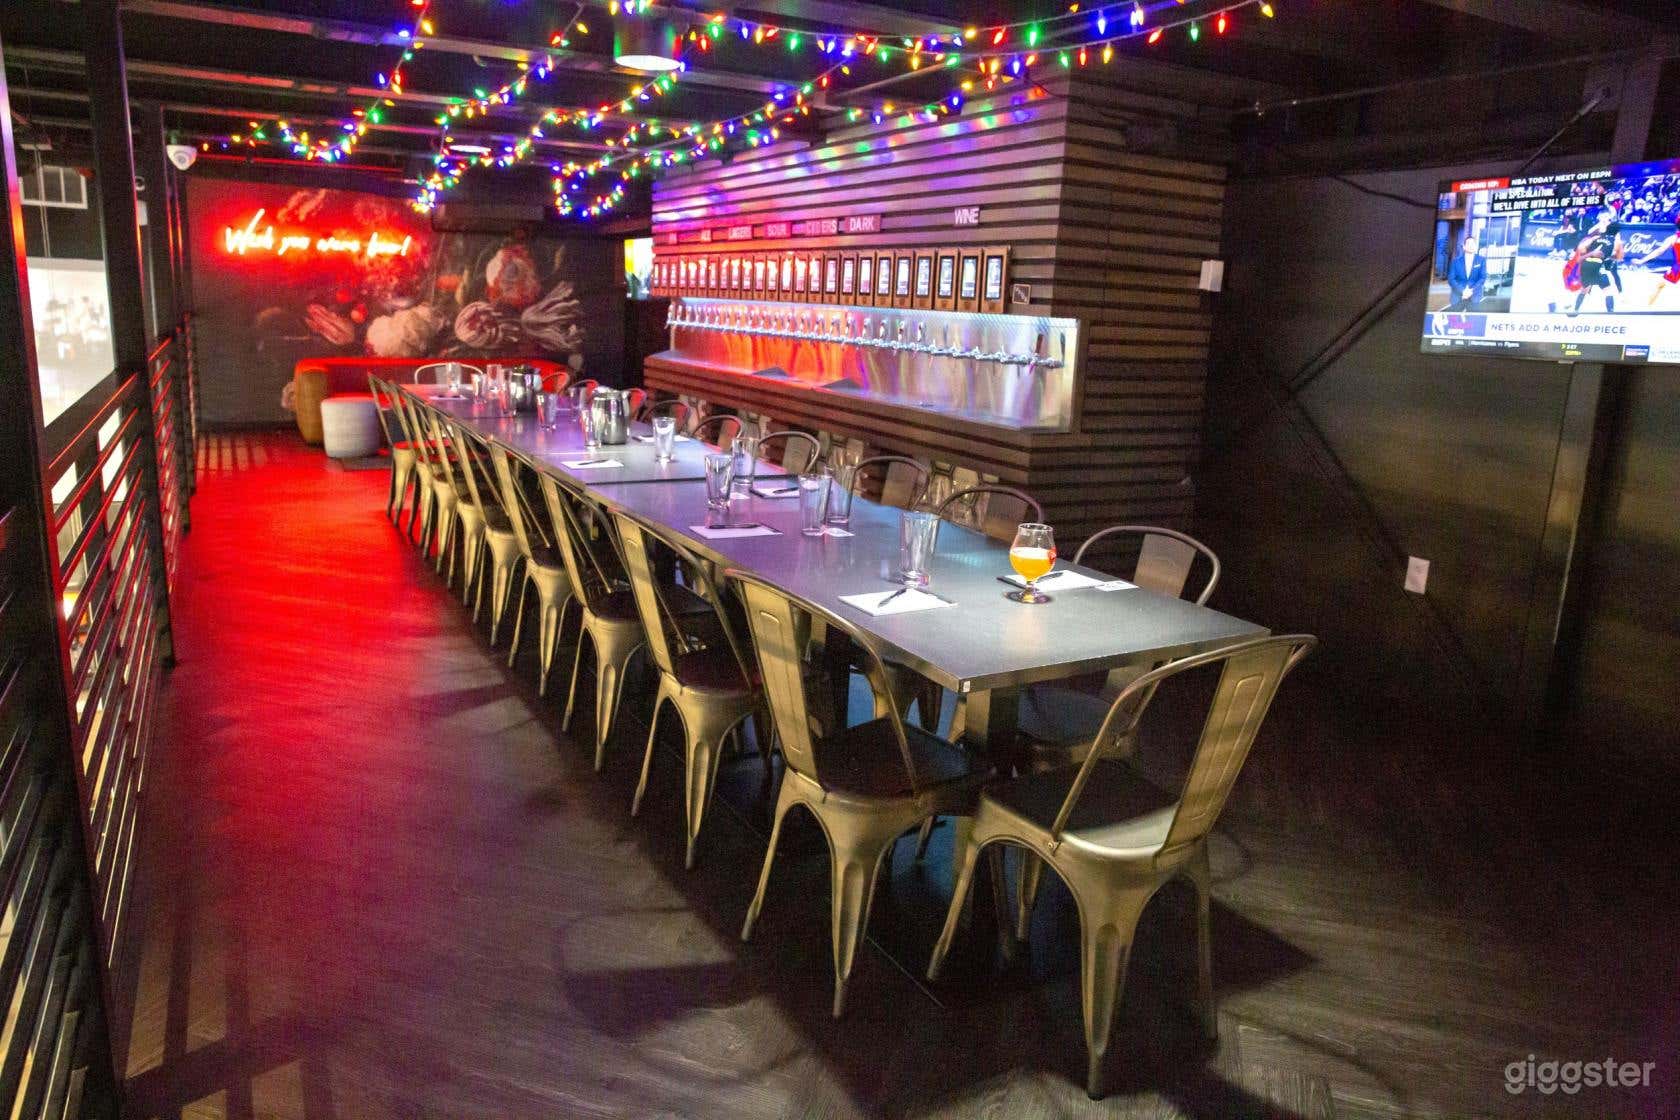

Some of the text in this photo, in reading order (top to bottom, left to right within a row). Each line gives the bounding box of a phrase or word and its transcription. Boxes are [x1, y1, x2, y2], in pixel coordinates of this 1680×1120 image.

[1511, 178, 1526, 186] NBA
[1528, 176, 1554, 185] TODAY
[1555, 174, 1575, 182] NEXT
[1577, 172, 1589, 181] ON
[1590, 170, 1611, 179] ESPN
[1547, 198, 1560, 207] ALL
[1561, 197, 1570, 207] OF
[1572, 196, 1586, 206] THE
[850, 216, 874, 231] DARK
[1624, 232, 1657, 255] Ford
[1491, 323, 1626, 334] NETS ADD A MAJOR PIECE
